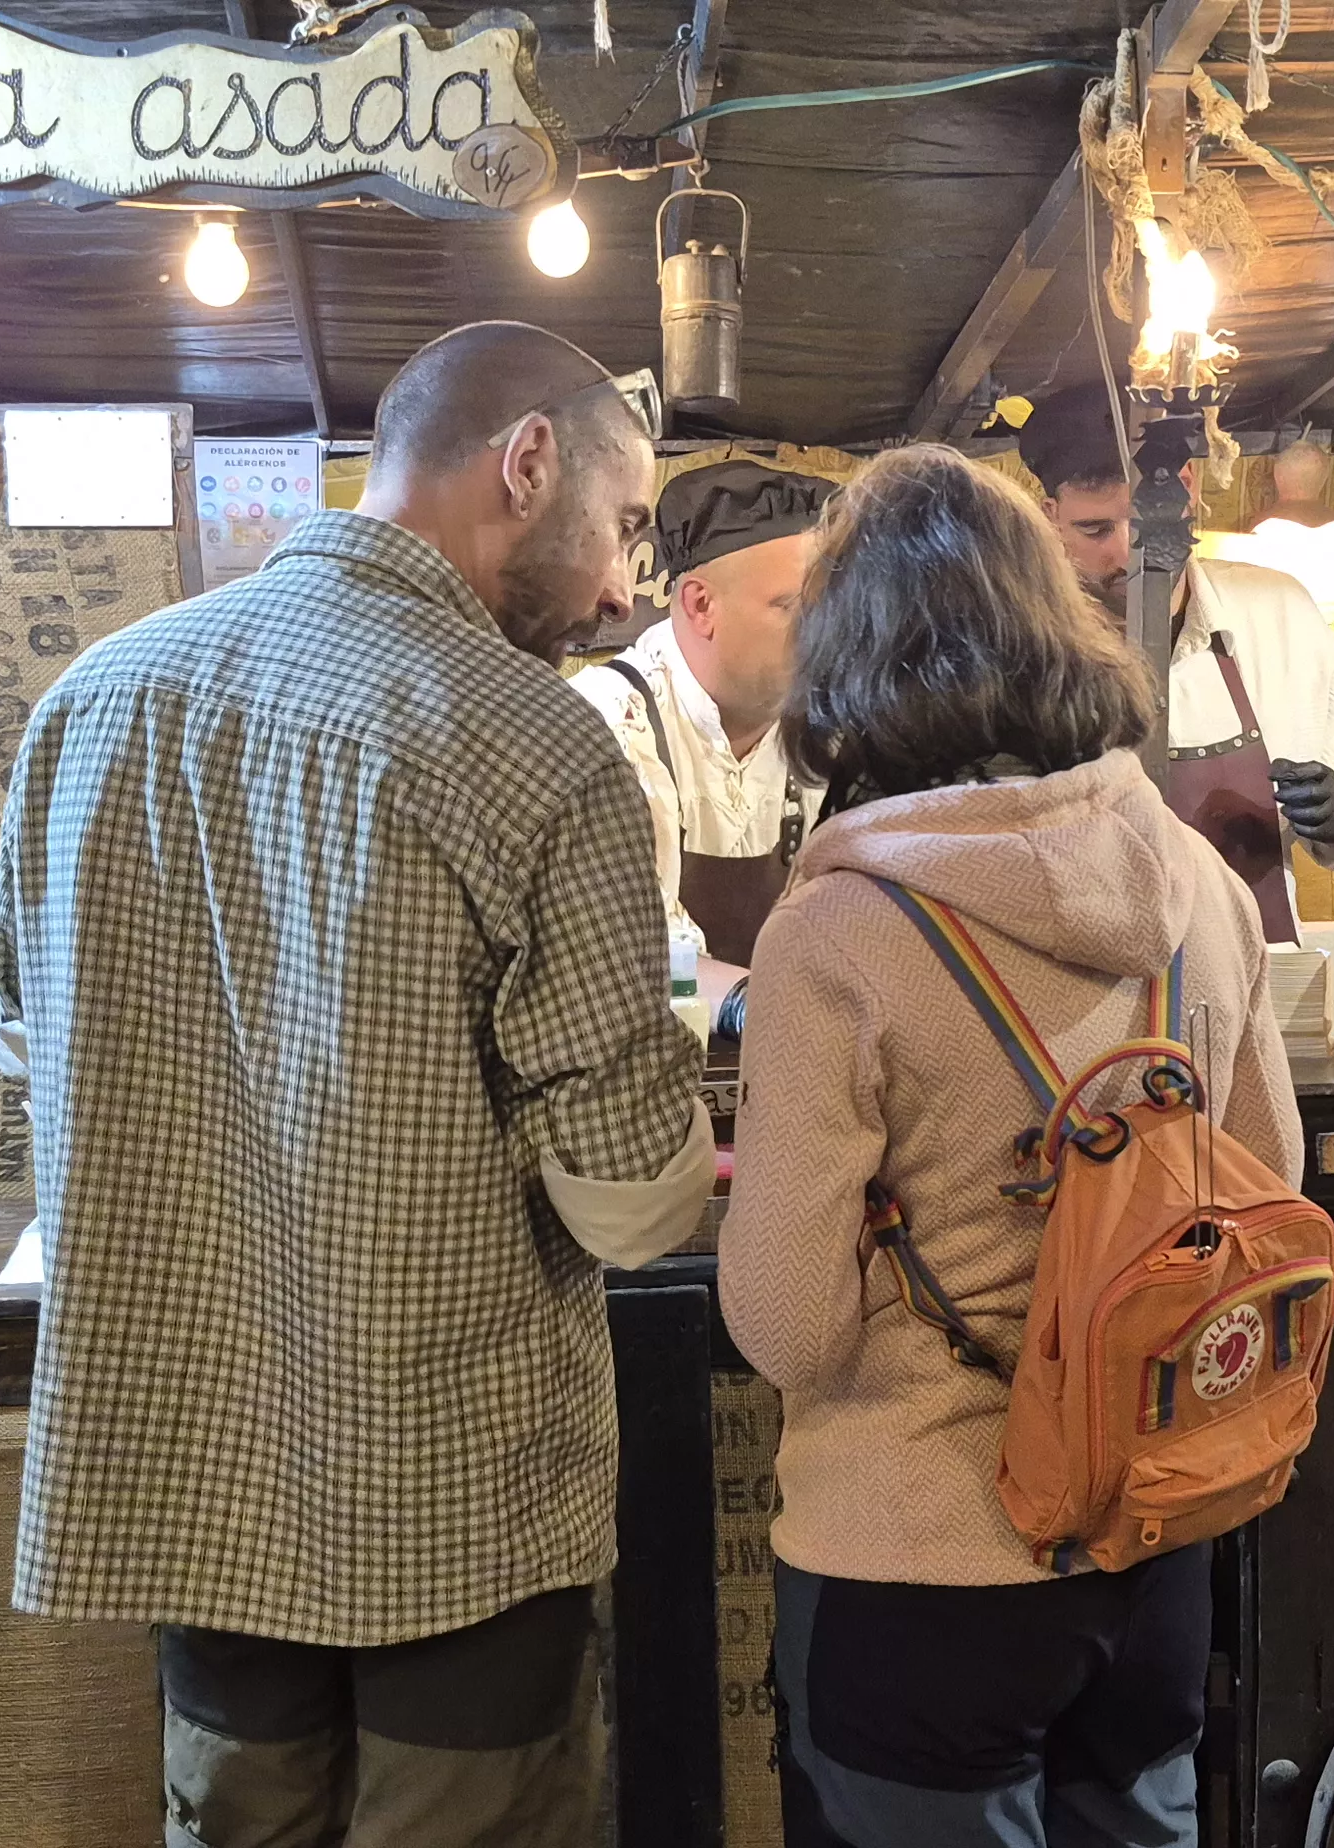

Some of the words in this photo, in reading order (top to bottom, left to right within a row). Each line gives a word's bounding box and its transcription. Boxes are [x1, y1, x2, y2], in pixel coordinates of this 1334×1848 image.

[131, 23, 507, 161] asada
[210, 446, 284, 456] DECLARACIÓN
[286, 448, 301, 456] DE
[224, 458, 287, 468] ALÉRGENOS
